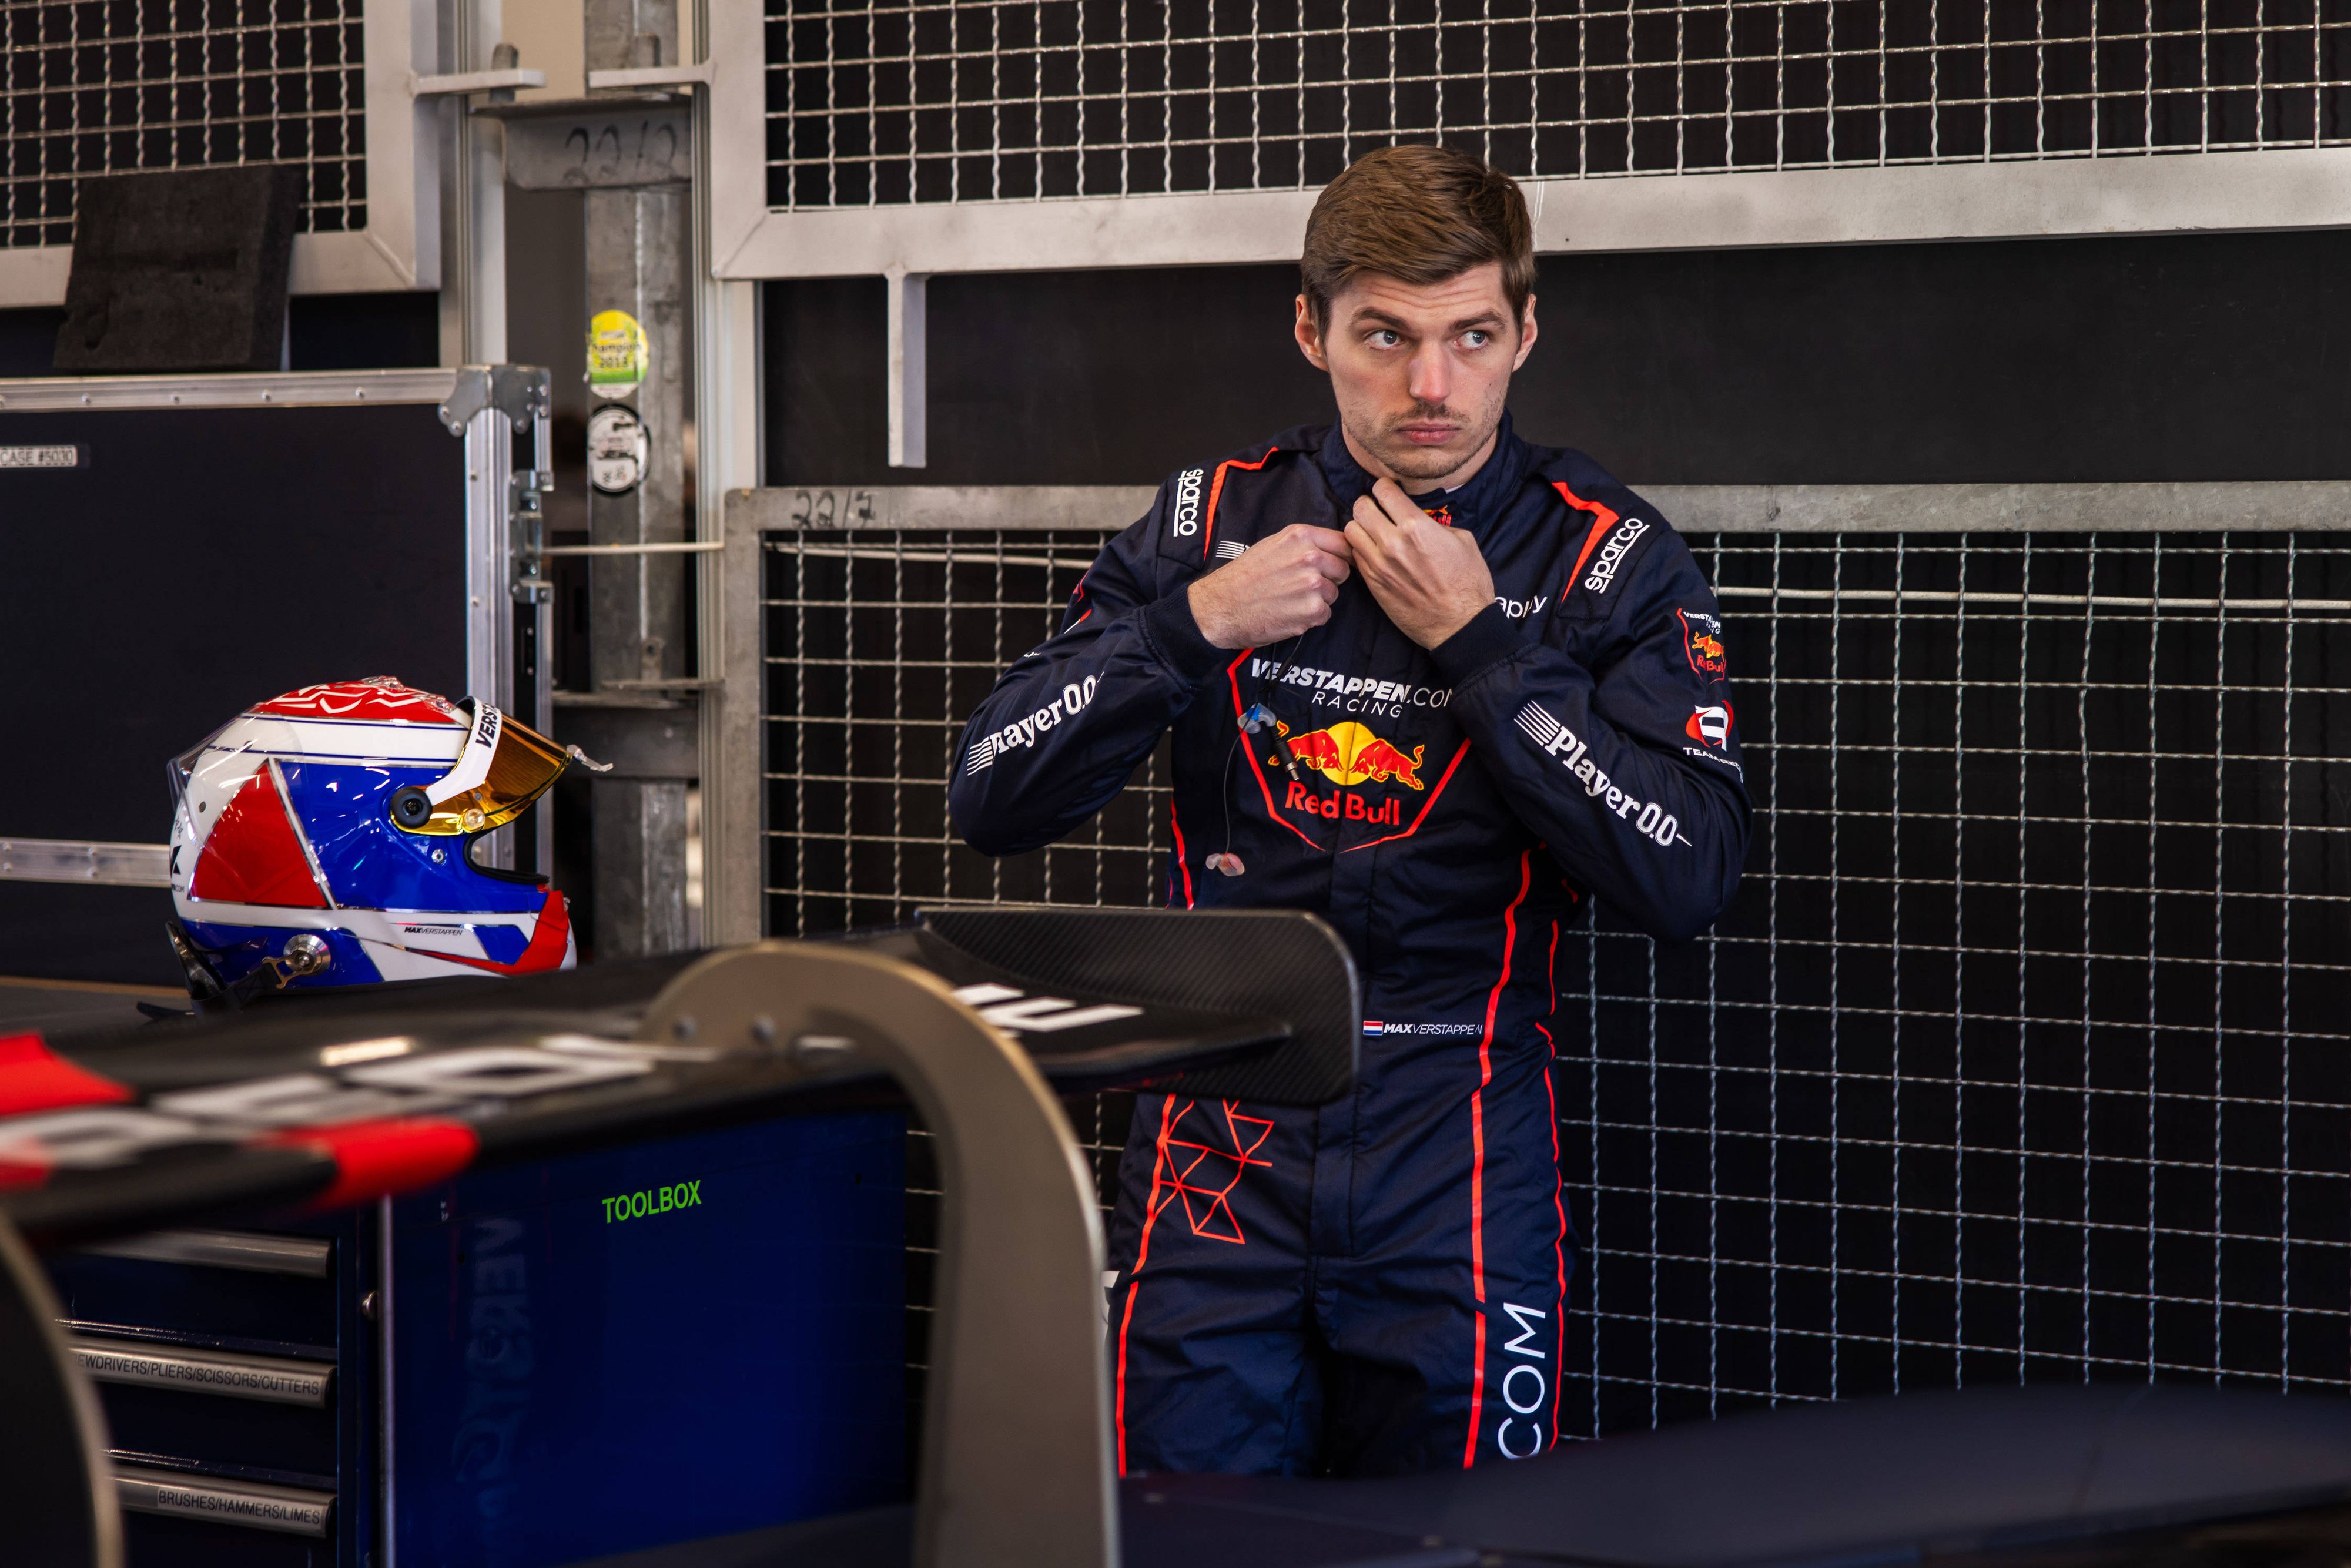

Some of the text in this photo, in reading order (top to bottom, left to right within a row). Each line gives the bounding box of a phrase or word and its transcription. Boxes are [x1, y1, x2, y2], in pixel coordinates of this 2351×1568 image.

[1176, 468, 1204, 537] sparco
[1585, 518, 1647, 592] sparco
[1312, 691, 1402, 718] RACING
[1285, 781, 1400, 826] Red Bull
[602, 1180, 702, 1224] TOOLBOX
[159, 1490, 320, 1525] BRUSHES/HAMMERS/LIMES
